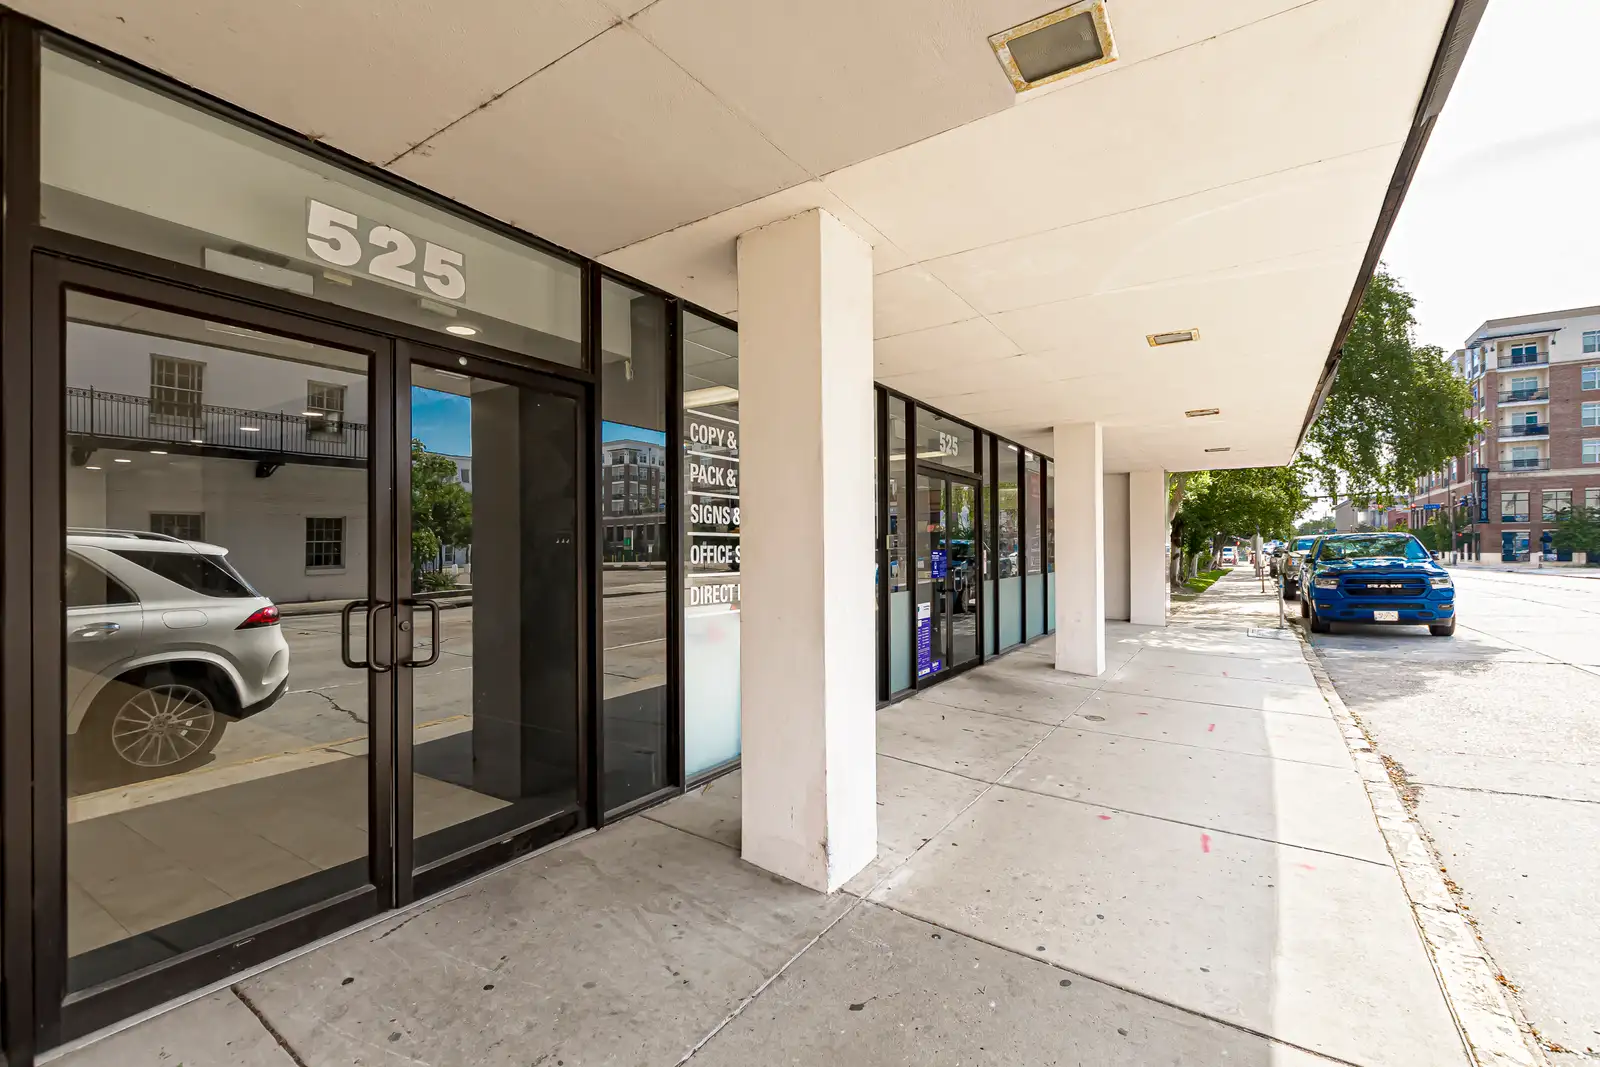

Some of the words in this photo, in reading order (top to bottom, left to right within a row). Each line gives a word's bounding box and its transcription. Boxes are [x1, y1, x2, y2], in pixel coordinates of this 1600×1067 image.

[306, 199, 466, 300] 525
[690, 422, 725, 447] COPY
[727, 430, 738, 450] &
[939, 431, 959, 456] 525
[690, 463, 725, 486] PACK
[726, 468, 737, 488] &
[690, 503, 731, 525] SIGNS
[690, 544, 733, 565] OFFICE
[690, 584, 736, 606] DIRECT
